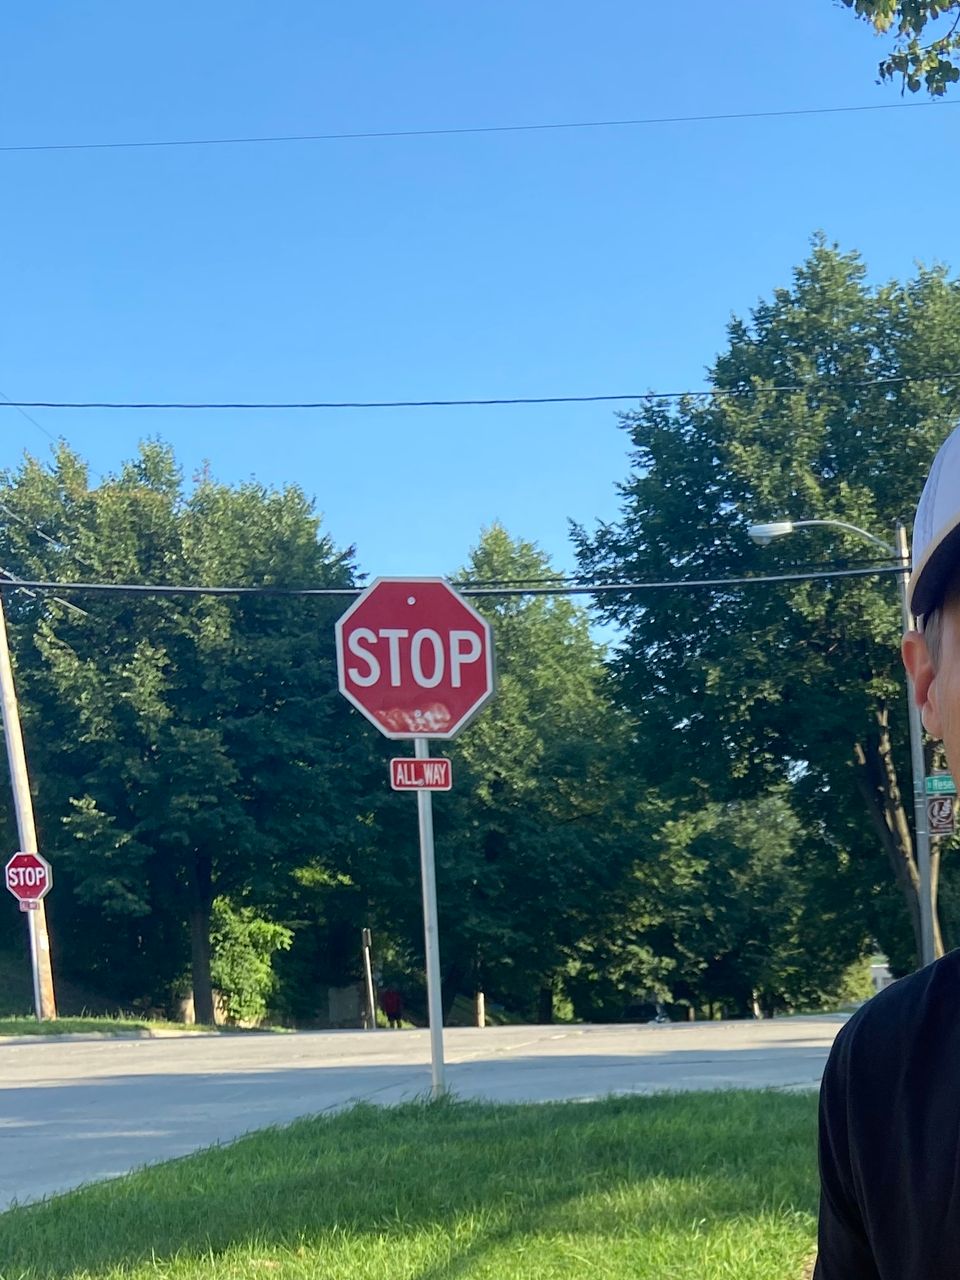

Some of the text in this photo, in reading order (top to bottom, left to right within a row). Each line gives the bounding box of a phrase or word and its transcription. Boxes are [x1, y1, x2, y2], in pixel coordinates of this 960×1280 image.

[348, 628, 482, 688] STOP
[396, 763, 447, 785] ALL WAY
[8, 867, 45, 886] STOP
